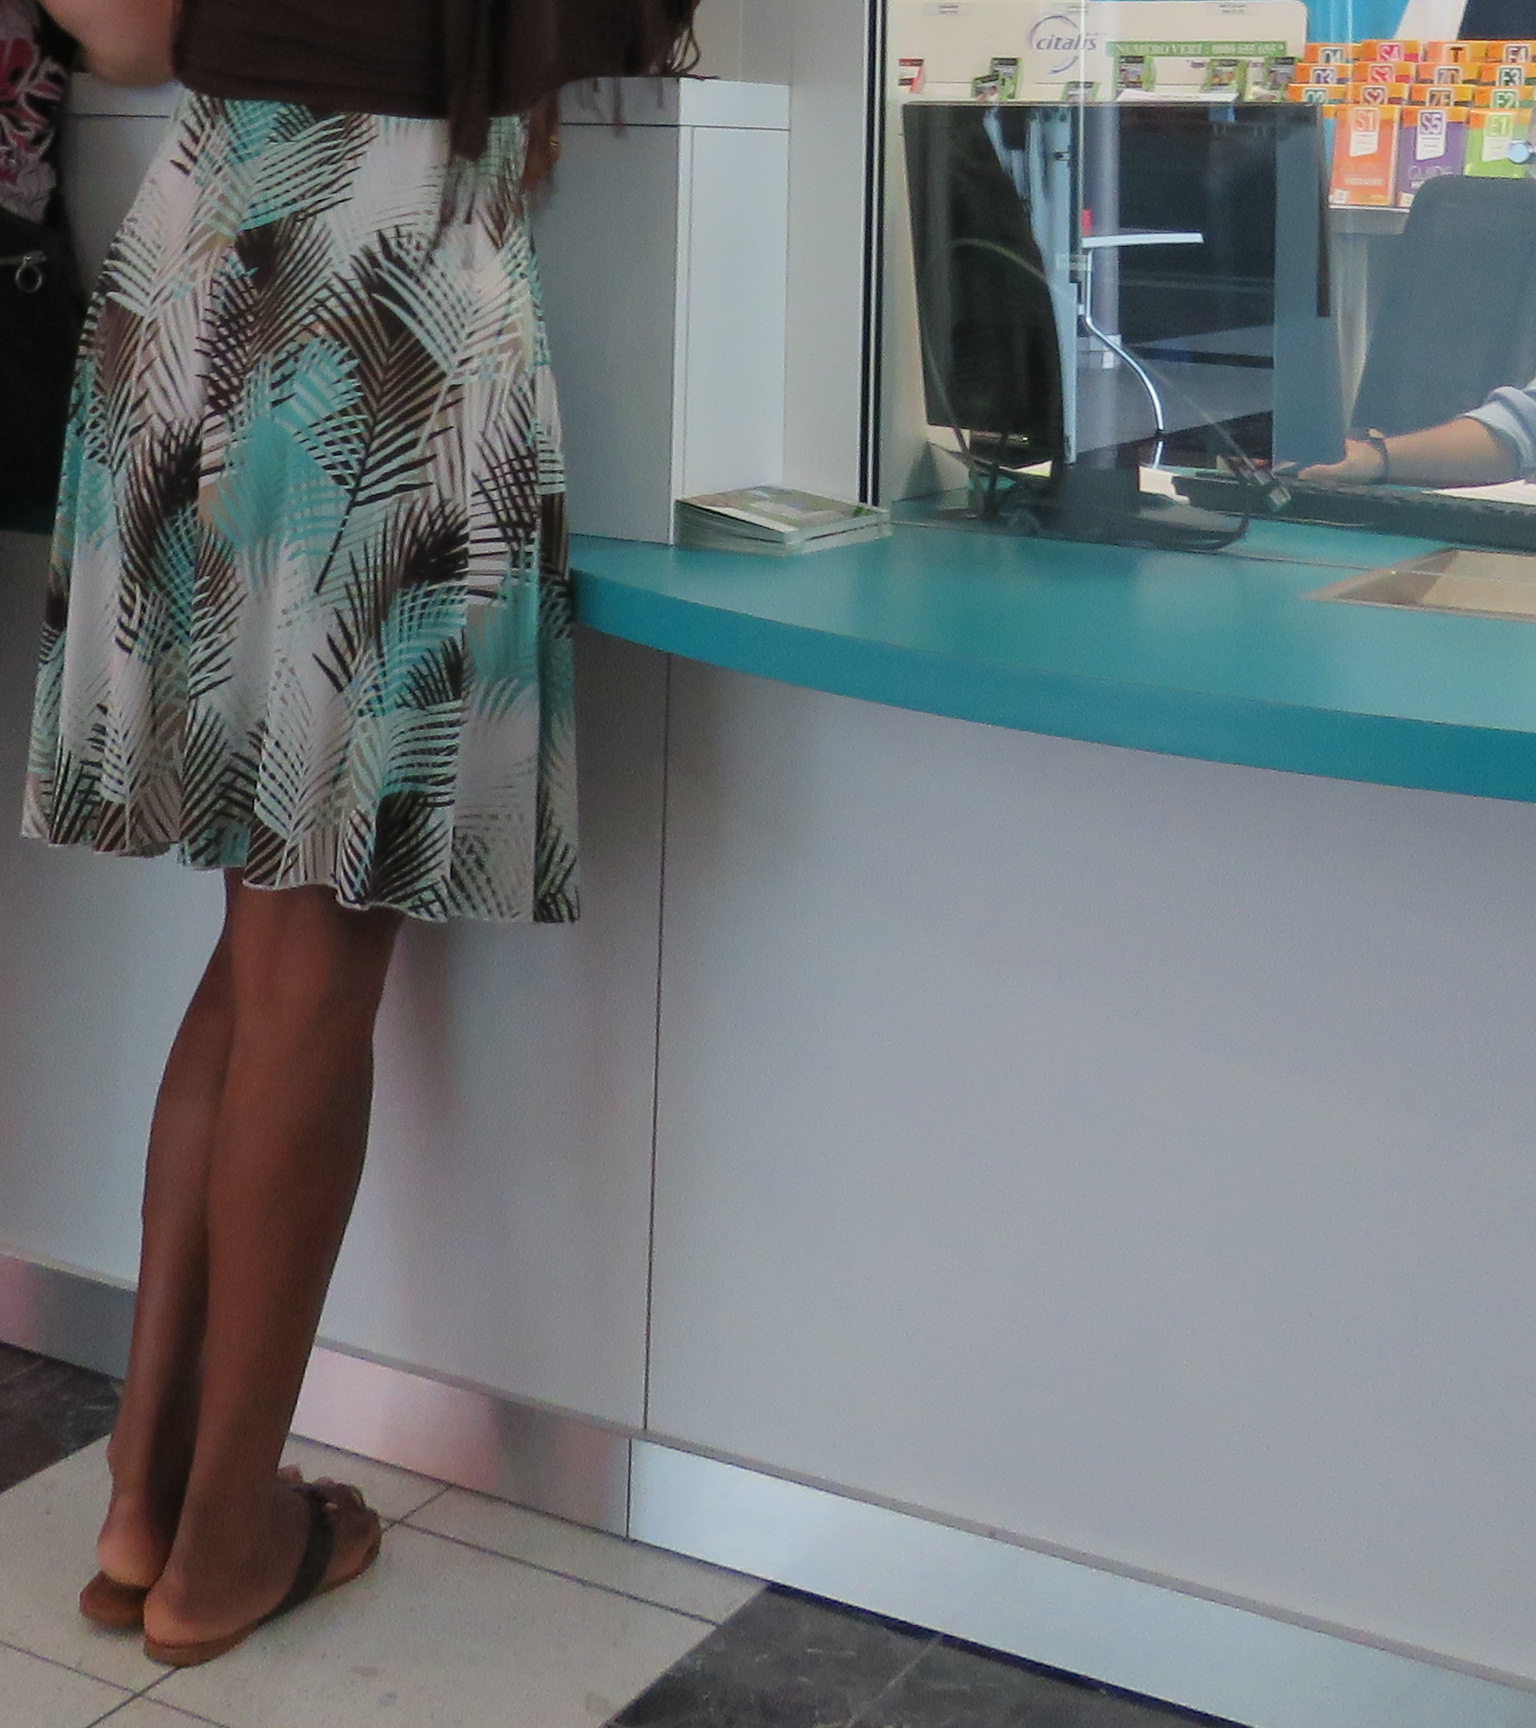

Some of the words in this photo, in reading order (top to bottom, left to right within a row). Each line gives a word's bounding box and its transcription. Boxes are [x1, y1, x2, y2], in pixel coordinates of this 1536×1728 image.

[1036, 34, 1098, 51] citalis
[1356, 110, 1376, 131] S1
[1422, 111, 1443, 135] S5
